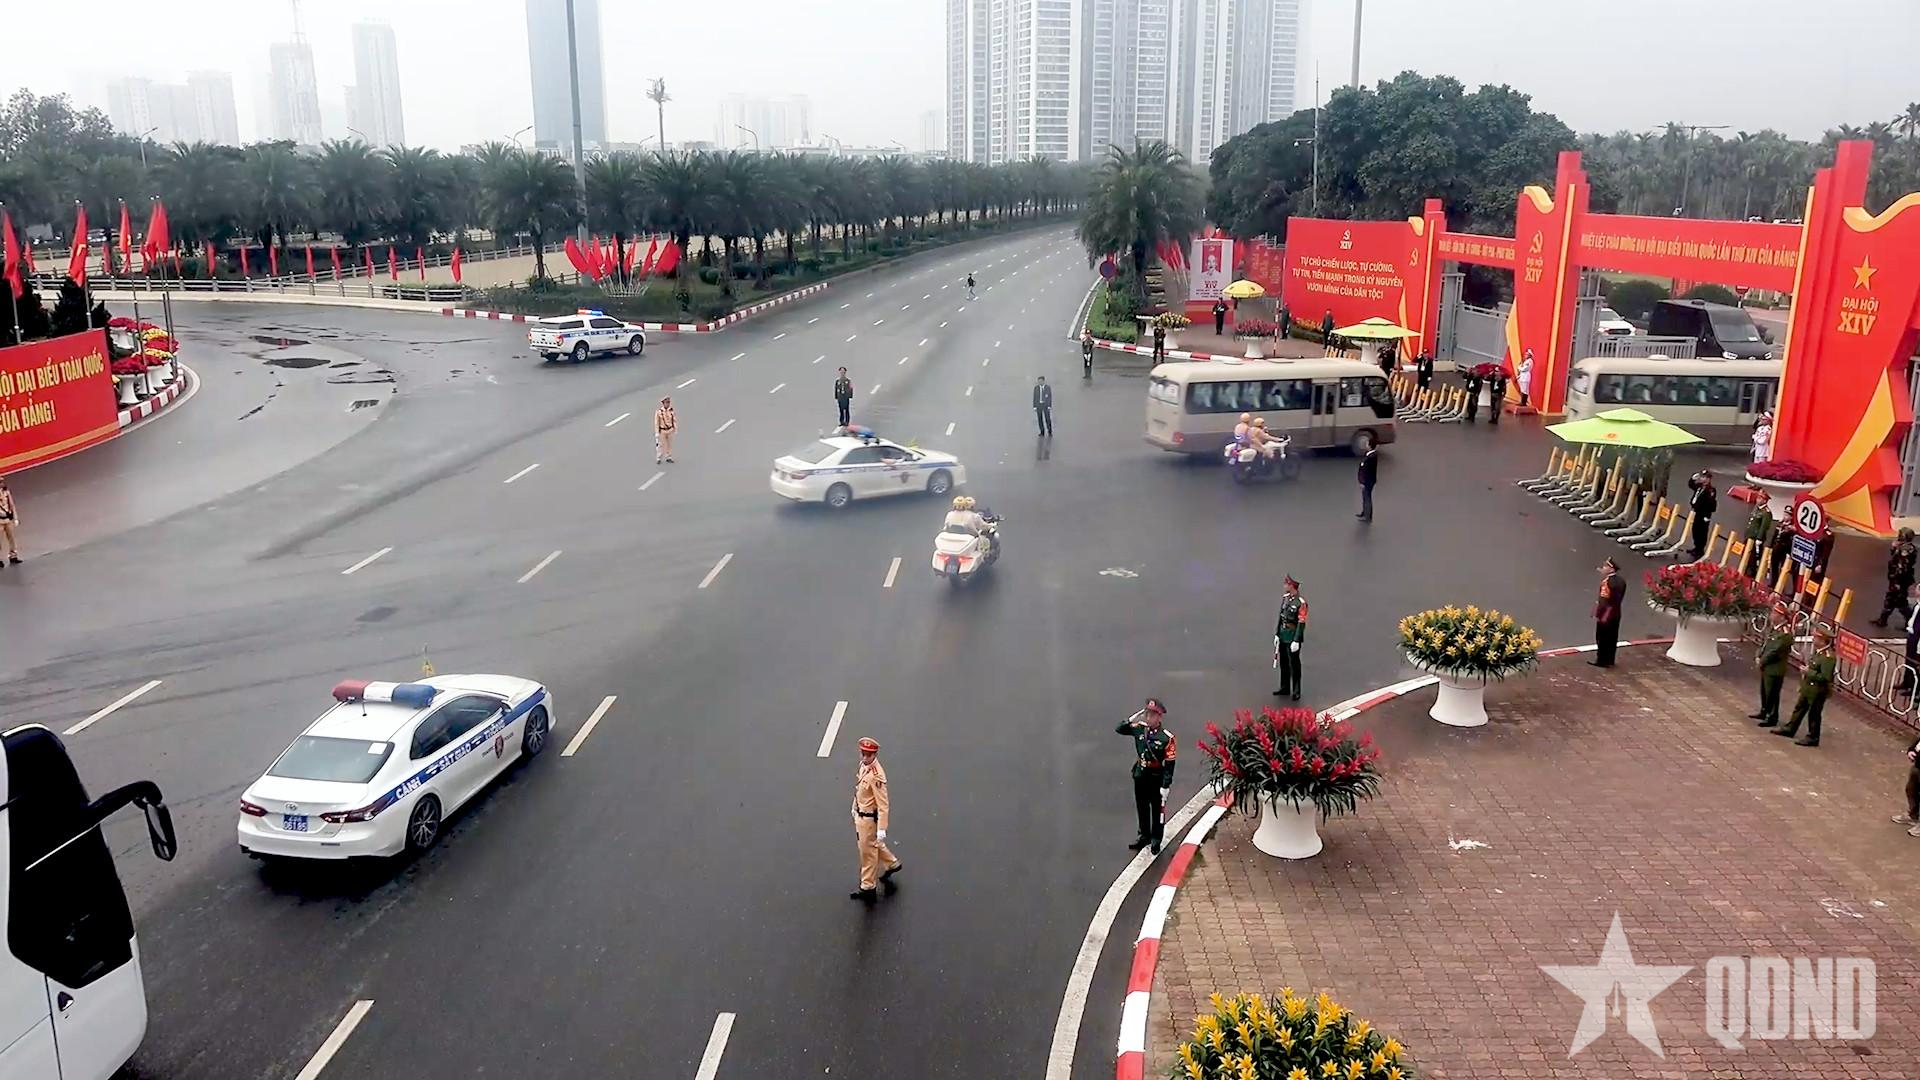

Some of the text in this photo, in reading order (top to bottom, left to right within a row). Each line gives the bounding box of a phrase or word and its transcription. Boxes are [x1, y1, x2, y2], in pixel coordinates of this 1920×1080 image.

[1309, 255, 1322, 267] CHỦ
[1322, 257, 1340, 269] CHIẾN
[1744, 247, 1758, 263] XIV
[1758, 243, 1773, 265] CỦA
[1325, 272, 1344, 283] MẠNH
[1344, 273, 1365, 285] TRONG
[1375, 275, 1403, 287] NGUYÊN
[1525, 267, 1542, 283] XIV
[1842, 296, 1879, 314] ĐẠI HỘI
[1837, 311, 1876, 336] XIV
[0, 346, 104, 401] ỘI ĐẠI BIỂU TOÀN QUỐC
[21, 398, 56, 429] ĐẢNG!
[1800, 506, 1818, 530] 20
[395, 776, 422, 799] CẢNH
